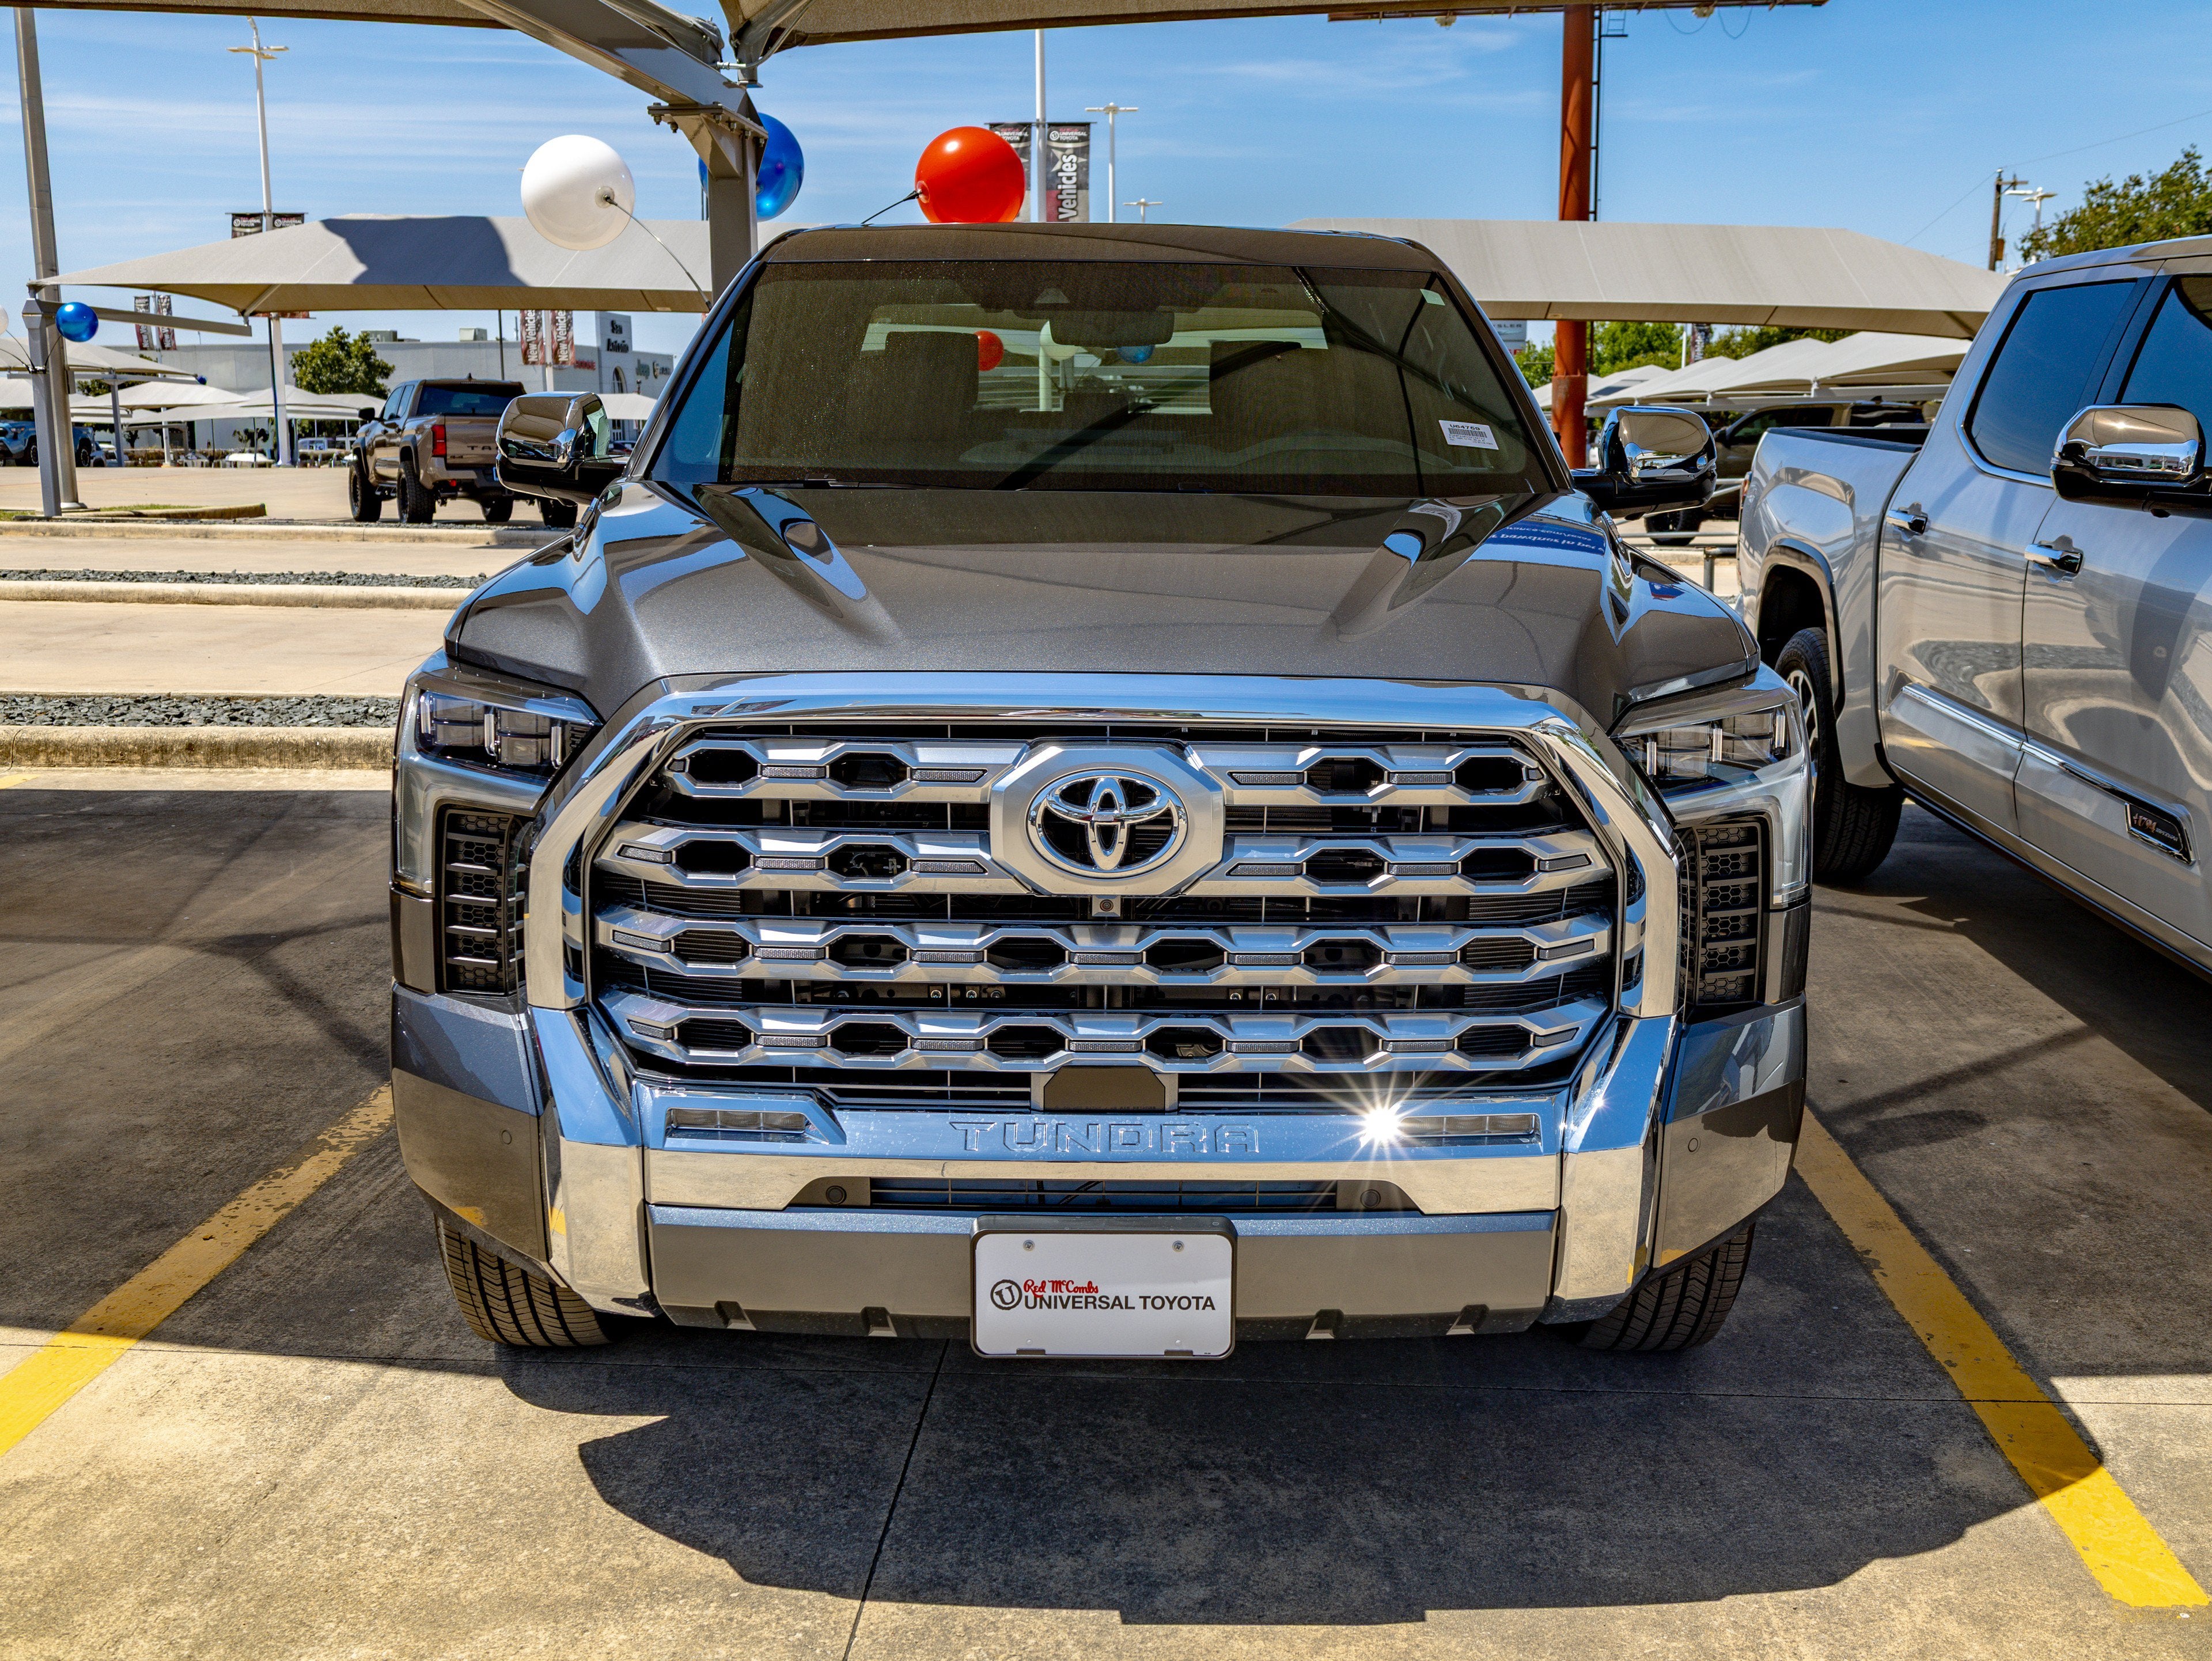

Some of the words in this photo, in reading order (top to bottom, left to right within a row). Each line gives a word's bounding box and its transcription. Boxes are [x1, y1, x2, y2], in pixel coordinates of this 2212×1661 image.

[1058, 154, 1077, 220] Vehicles
[525, 310, 536, 342] Vehicle
[556, 310, 567, 342] Vehicle
[528, 343, 538, 361] New
[558, 343, 569, 361] New
[949, 1122, 1259, 1153] TUNDRA
[1023, 1279, 1046, 1298] Red
[1047, 1279, 1099, 1293] McCombs
[1024, 1295, 1135, 1310] UNIVERSAL
[1139, 1296, 1216, 1310] TOYOTA
